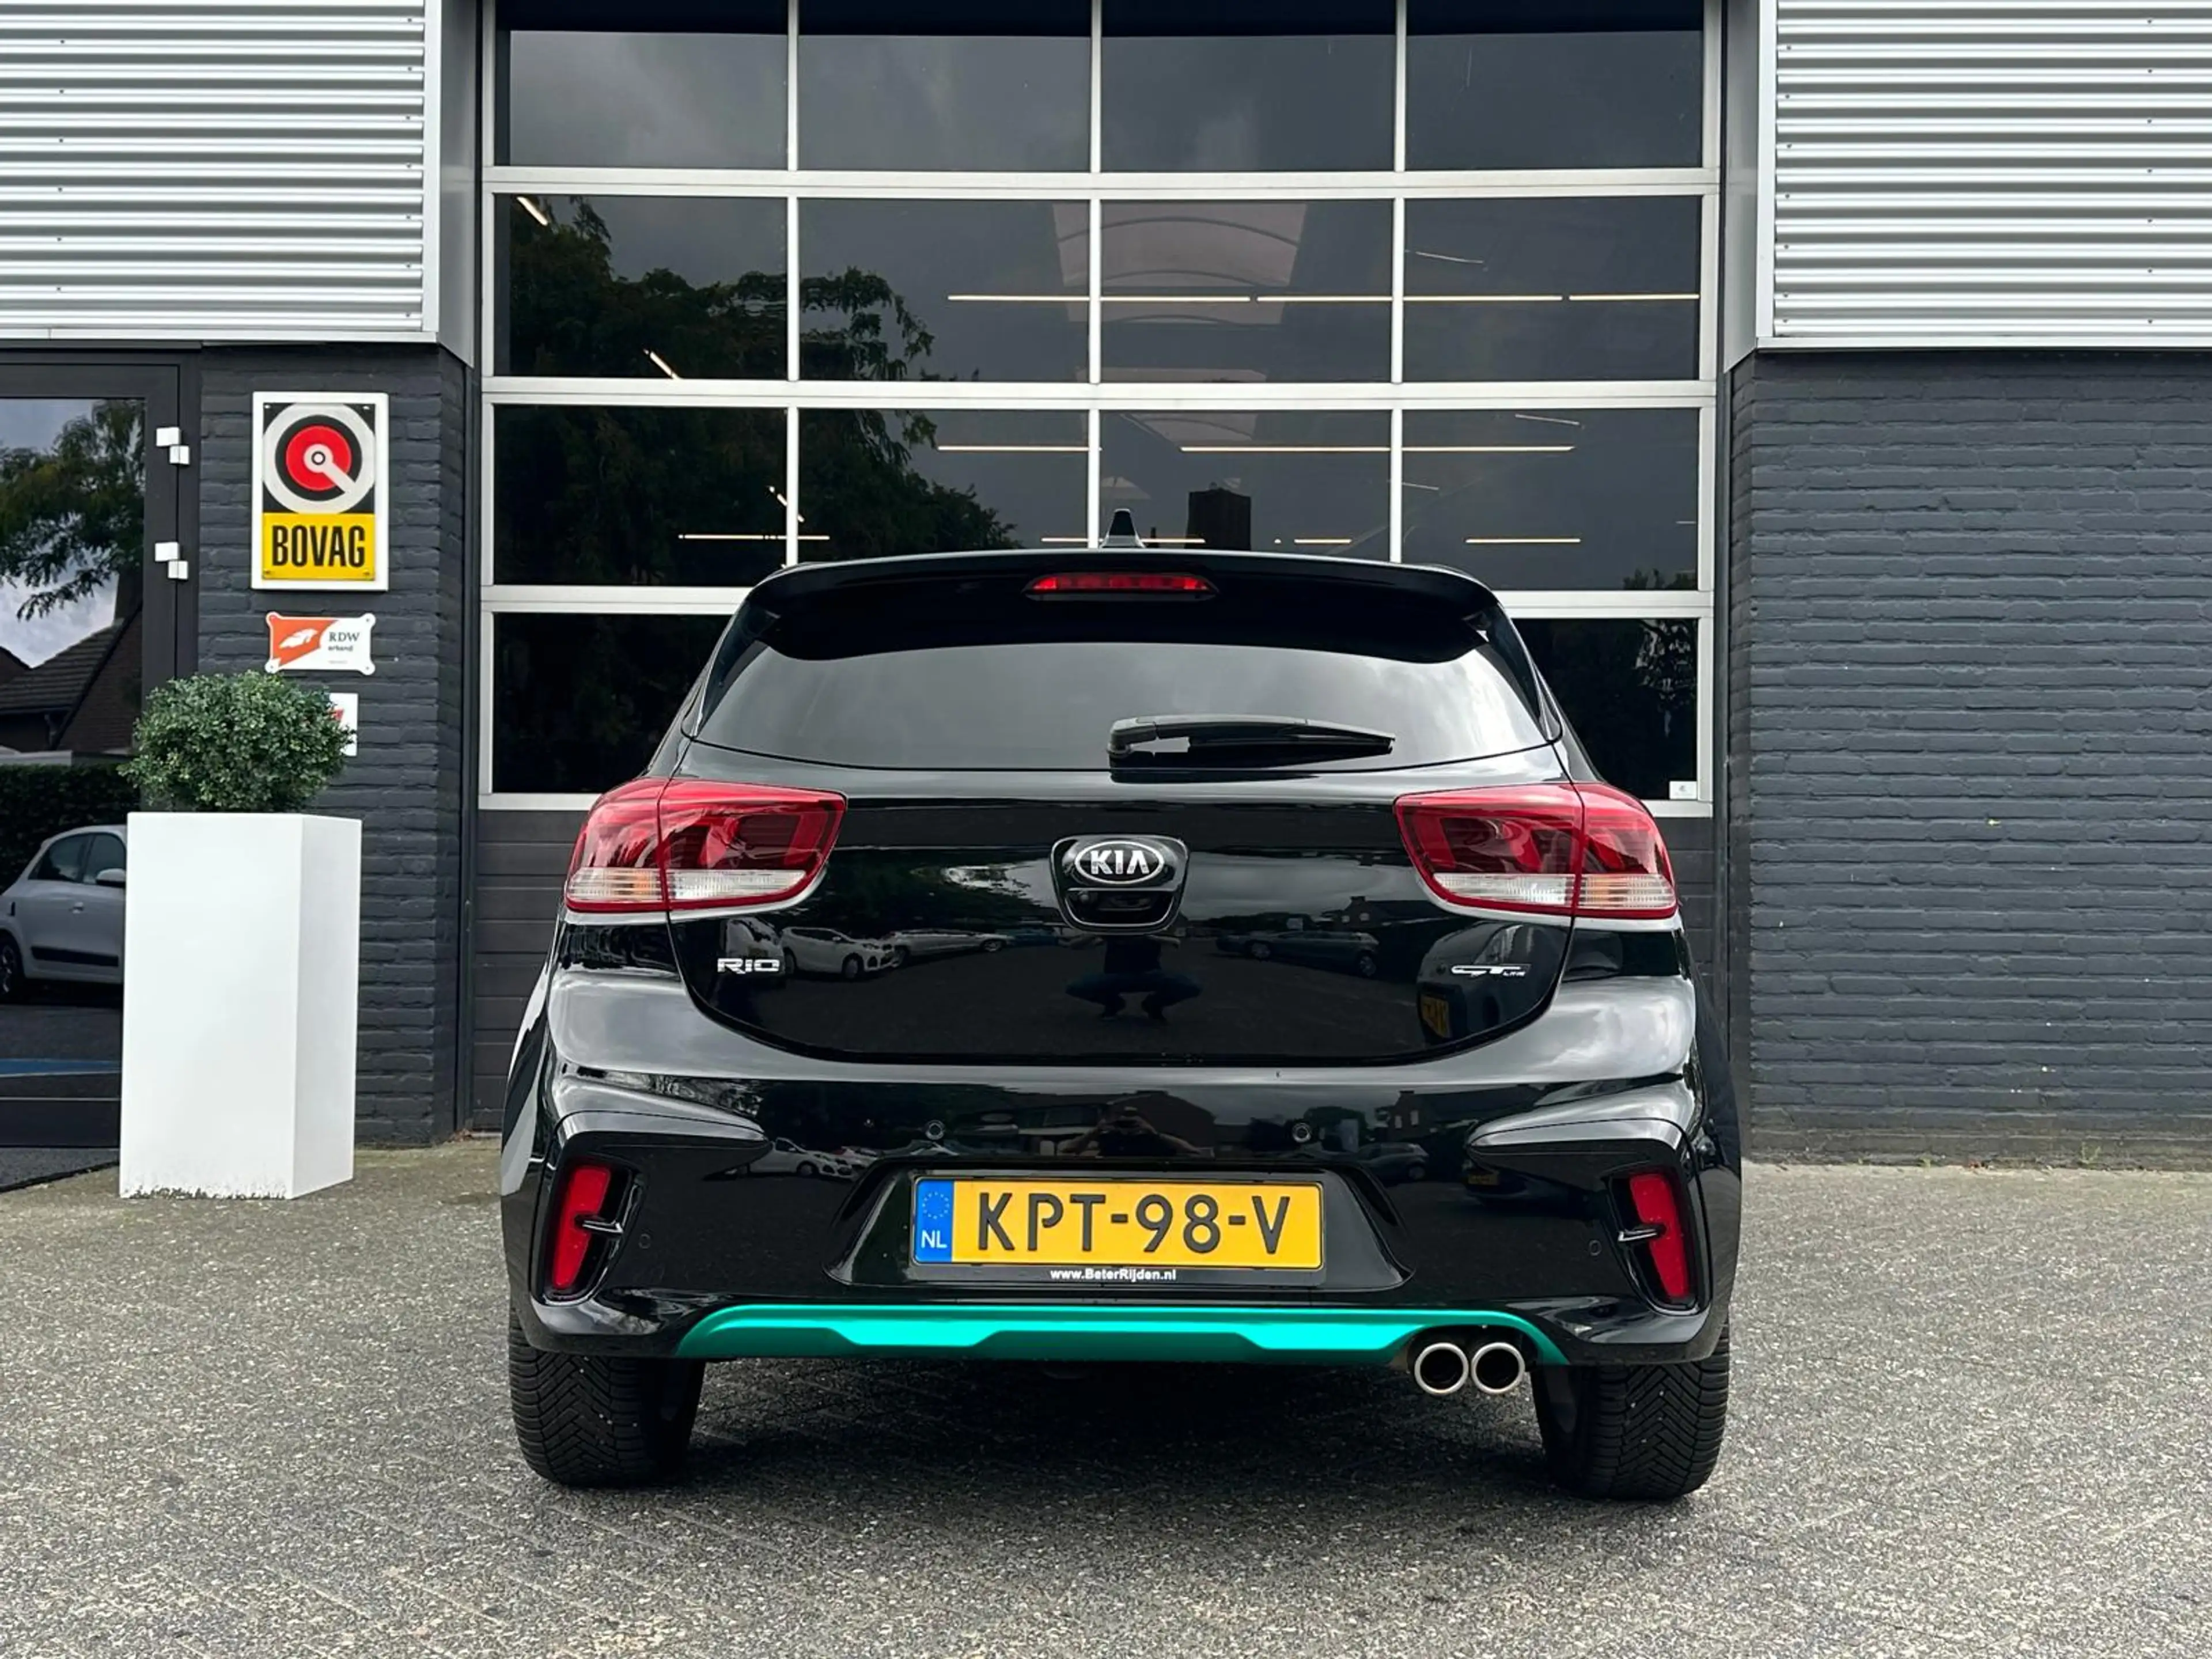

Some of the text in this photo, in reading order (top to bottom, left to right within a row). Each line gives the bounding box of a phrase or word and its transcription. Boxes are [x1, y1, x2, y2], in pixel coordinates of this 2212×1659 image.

[272, 525, 365, 567] BOVAG
[329, 631, 360, 642] RDW
[1090, 850, 1150, 874] KIA
[978, 1191, 1291, 1255] KPT-98-V
[921, 1230, 948, 1248] NL
[1050, 1268, 1177, 1282] www.BeterRijden.nl
